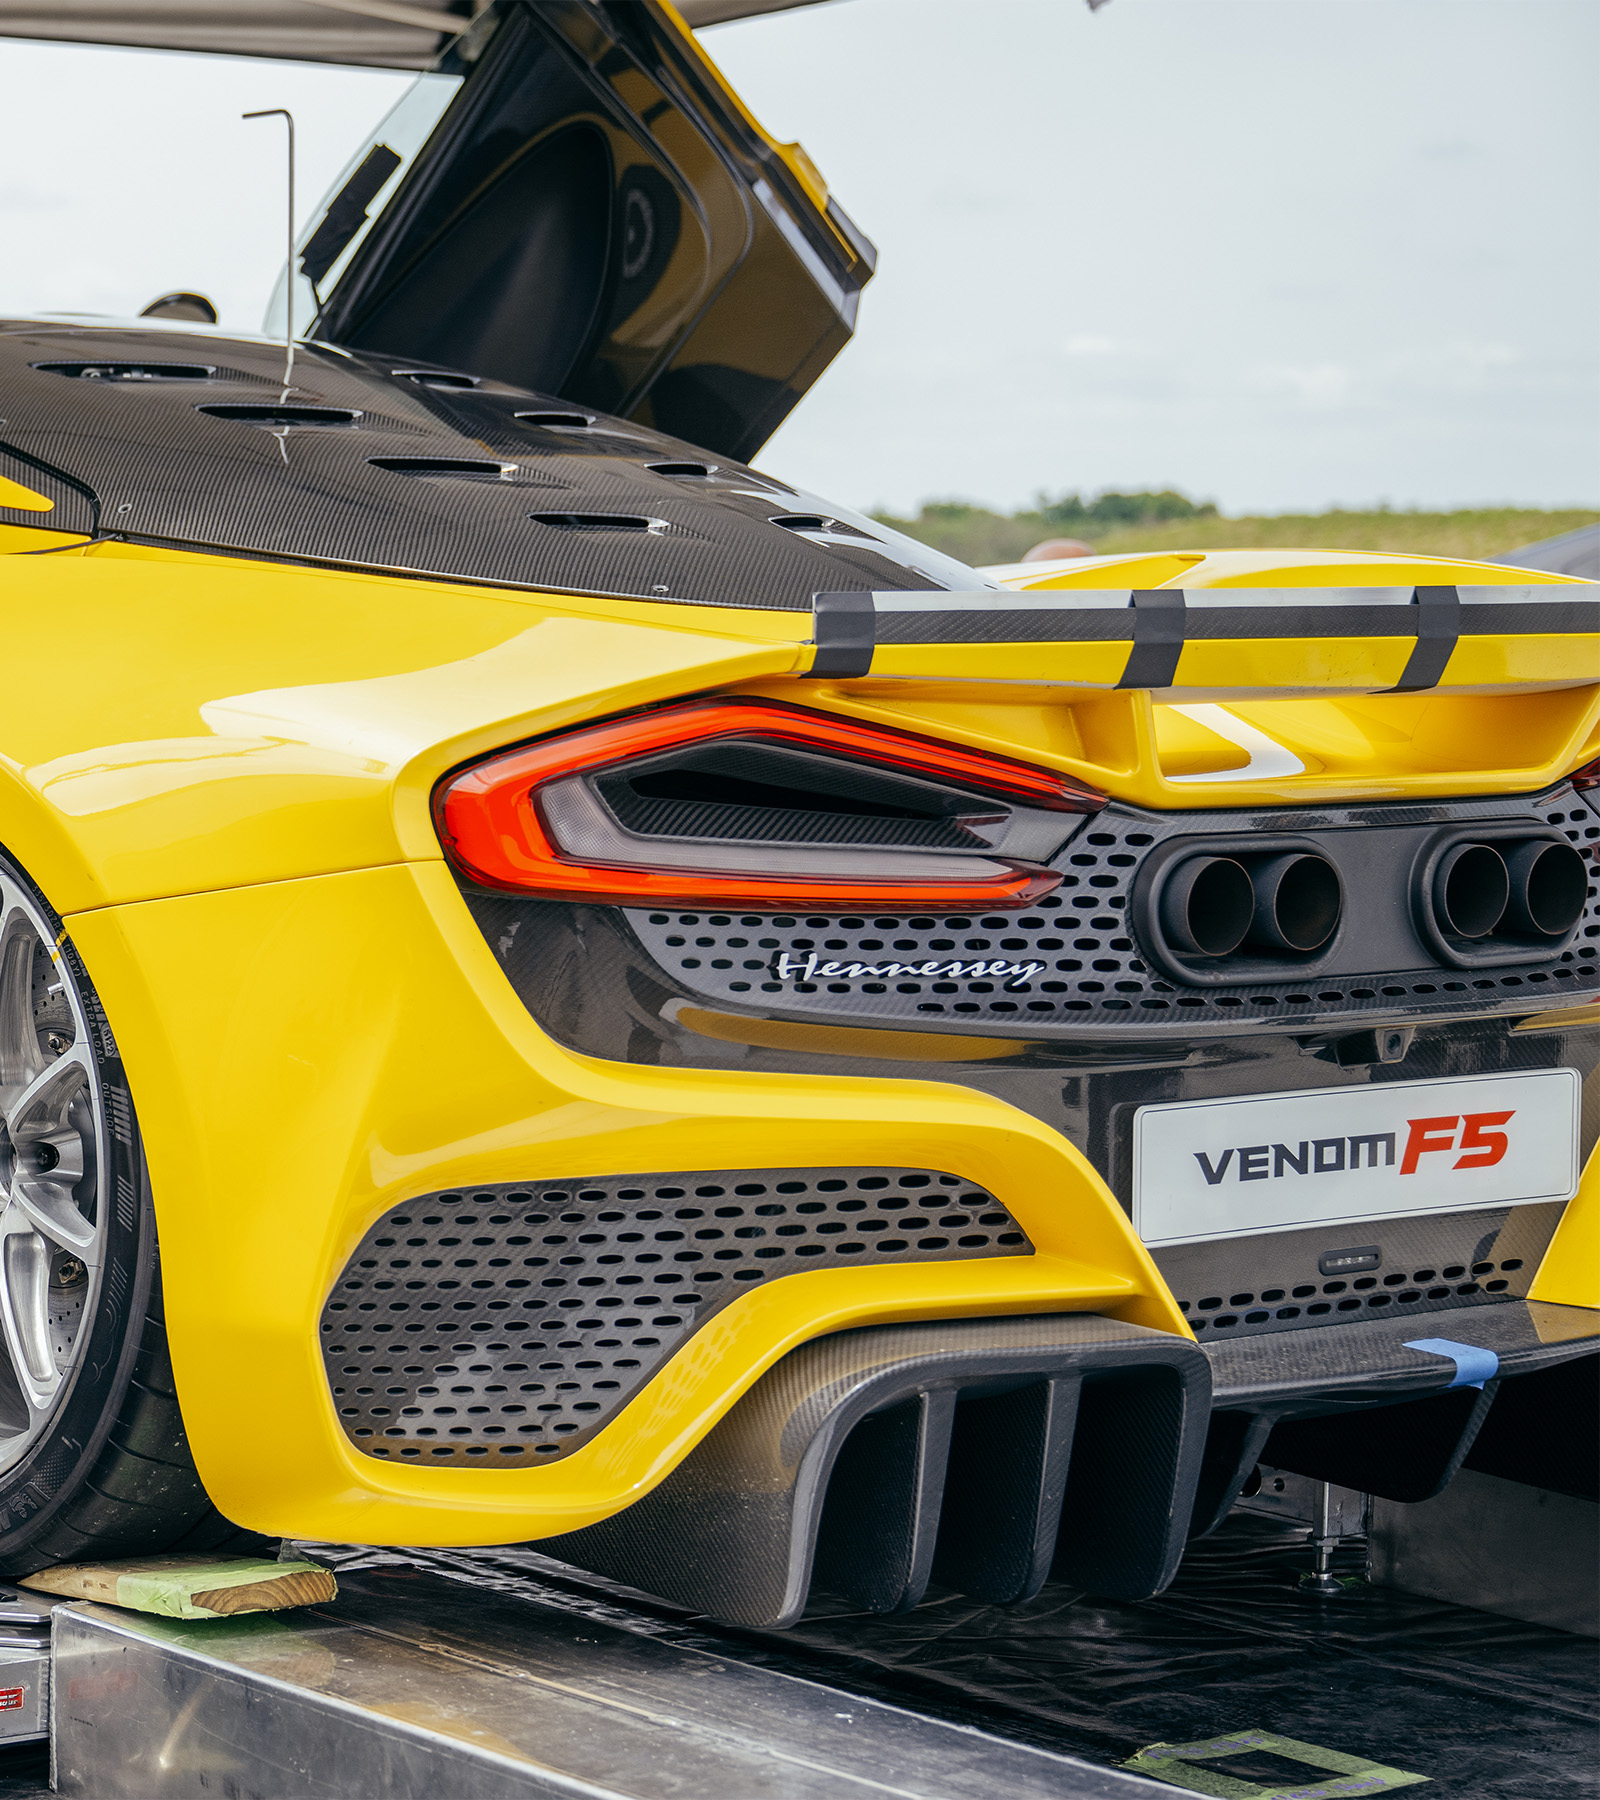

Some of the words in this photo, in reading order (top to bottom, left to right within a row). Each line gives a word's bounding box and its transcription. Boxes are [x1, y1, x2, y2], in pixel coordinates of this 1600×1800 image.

[63, 943, 82, 977] (108Y)
[776, 952, 1045, 987] Hennessey
[80, 991, 96, 1030] EXTRA
[92, 1032, 106, 1065] LOAD
[101, 1082, 115, 1136] OUTSIDE
[1192, 1132, 1396, 1185] VENOM
[1399, 1110, 1517, 1175] F5
